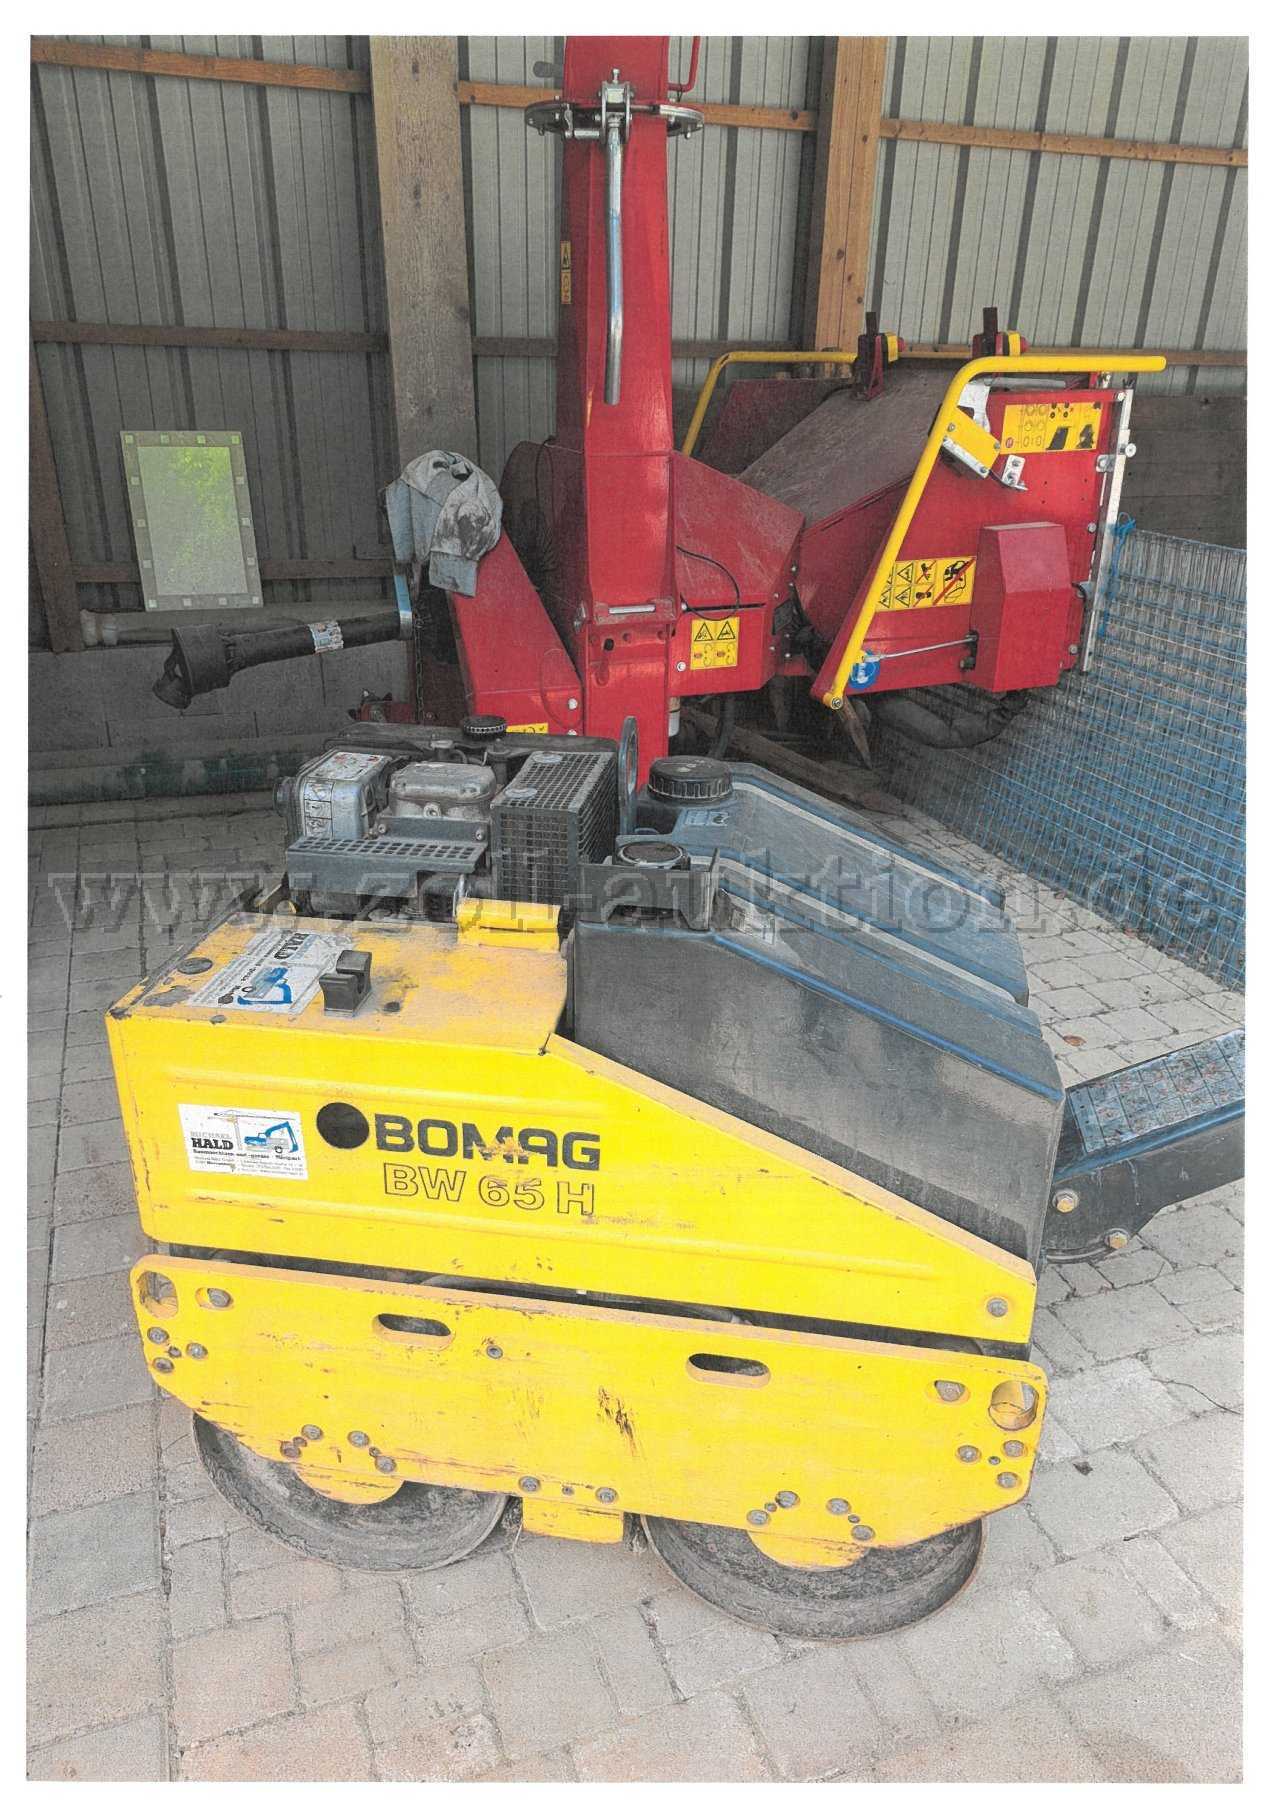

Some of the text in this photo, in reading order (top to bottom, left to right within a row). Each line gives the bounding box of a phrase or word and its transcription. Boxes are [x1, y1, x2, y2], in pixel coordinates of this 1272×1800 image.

[190, 1137, 234, 1150] HALD
[375, 1113, 601, 1171] BOMAG
[383, 1162, 595, 1216] BW 65 H
